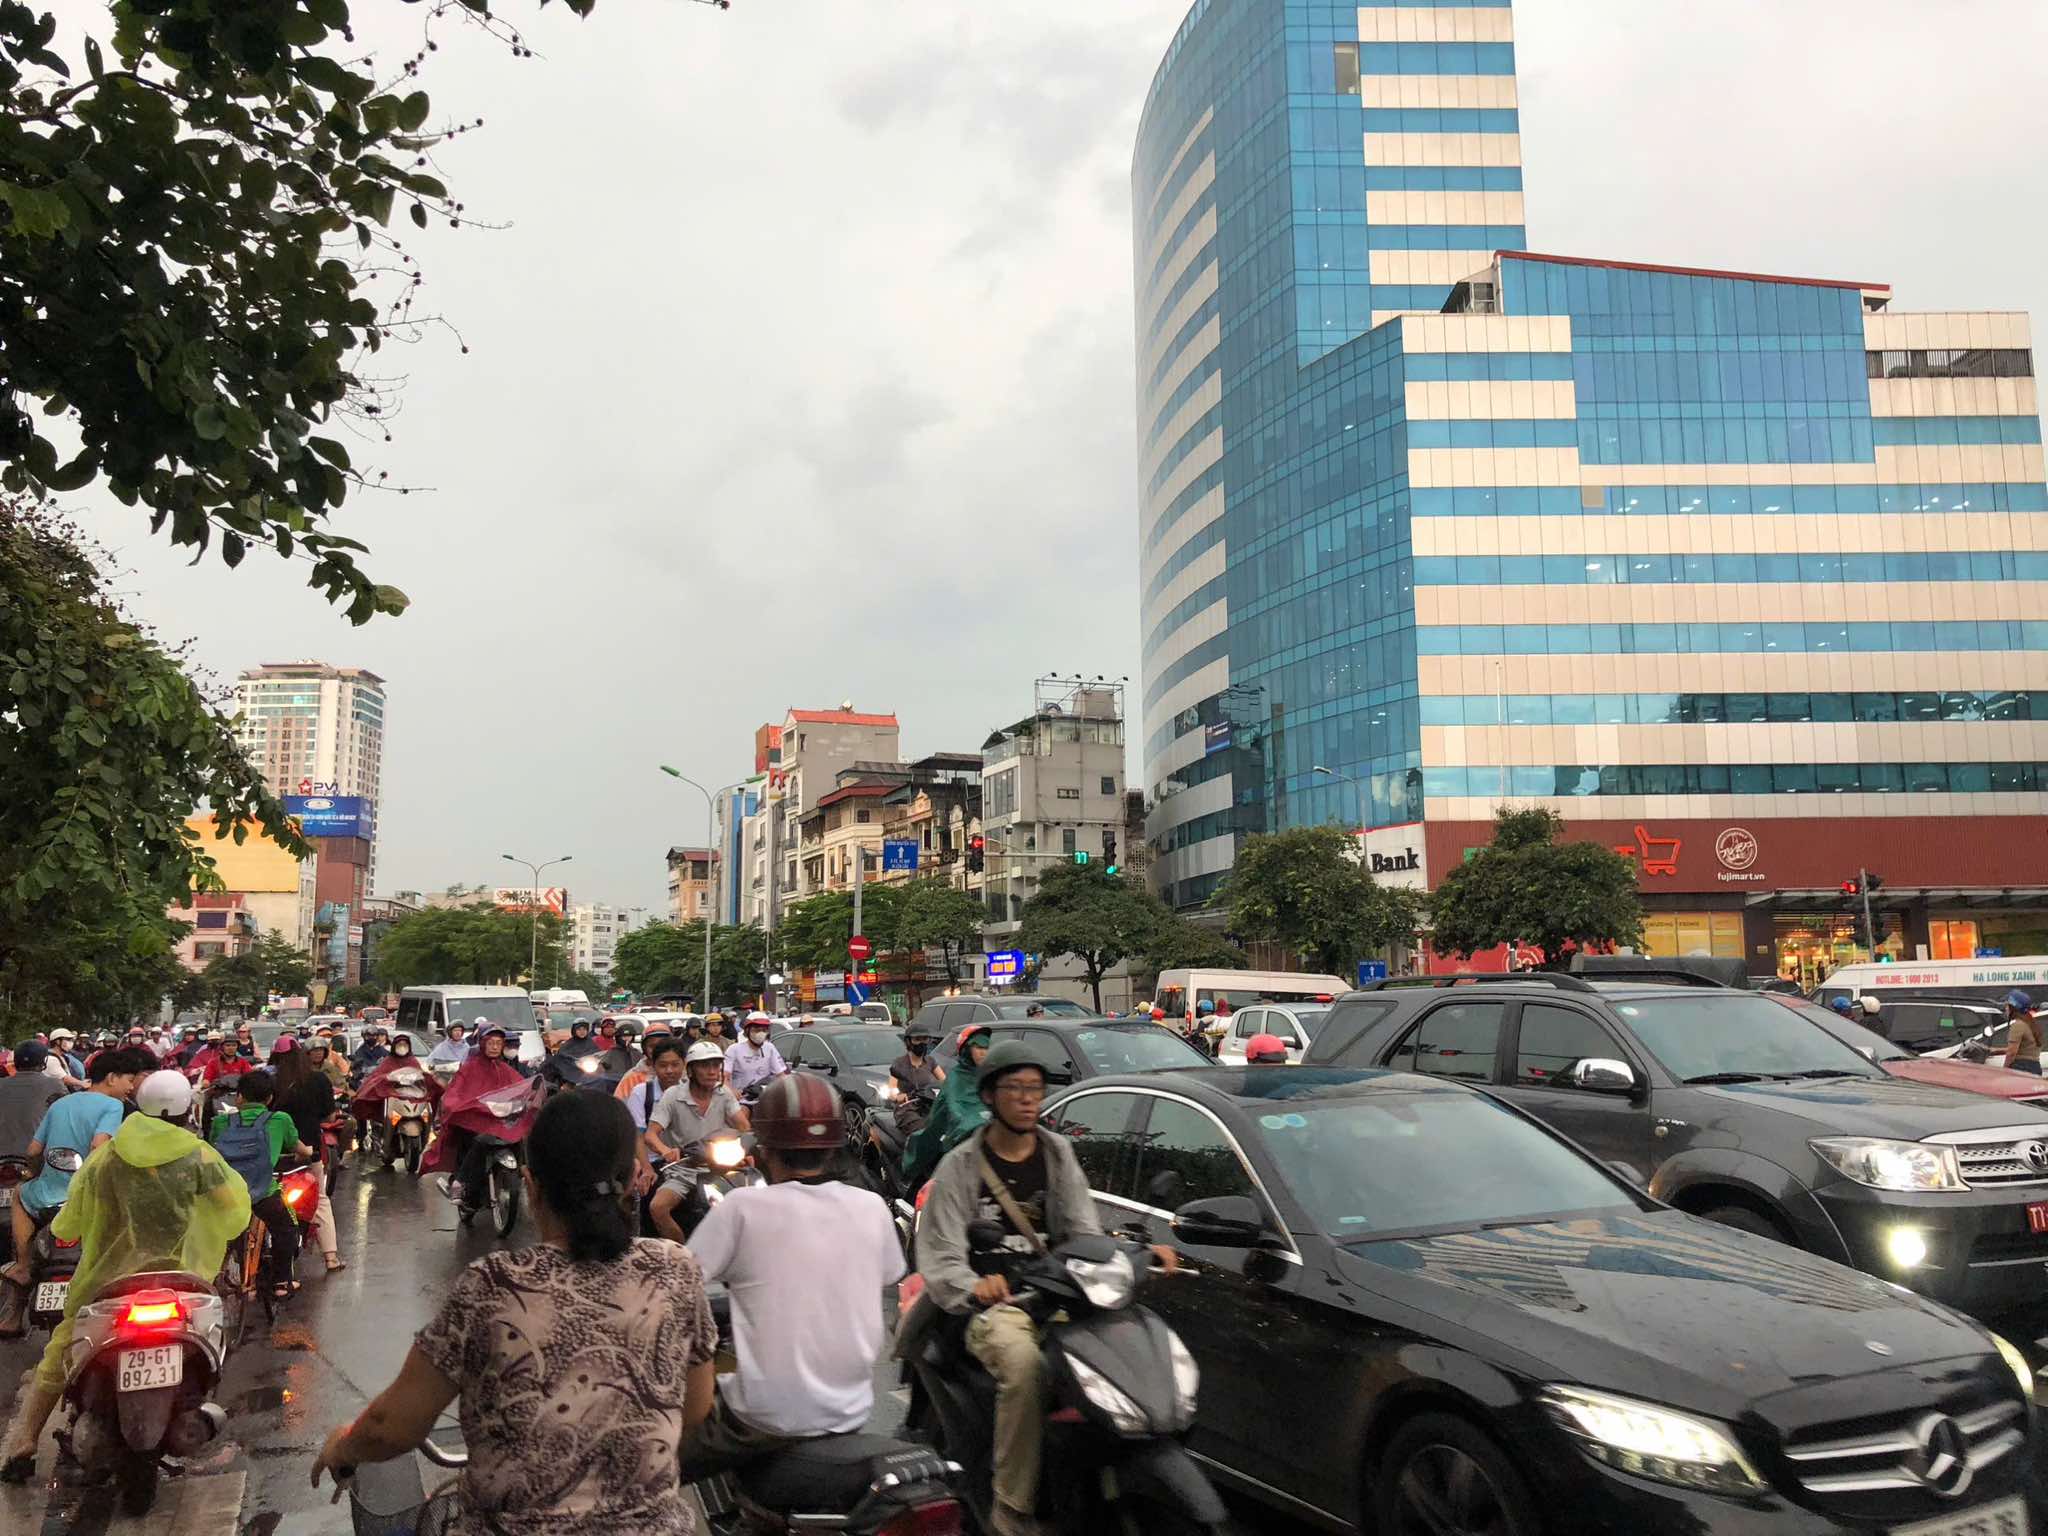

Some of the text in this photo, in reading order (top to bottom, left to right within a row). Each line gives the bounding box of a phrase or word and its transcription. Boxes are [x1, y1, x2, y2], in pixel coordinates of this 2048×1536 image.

[1370, 847, 1420, 874] Bank
[1717, 872, 1765, 882] fujimart.vn
[1986, 971, 2010, 982] LONG
[2012, 970, 2036, 982] XANH
[127, 1348, 171, 1369] 29-G1
[122, 1365, 177, 1389] 892.31
